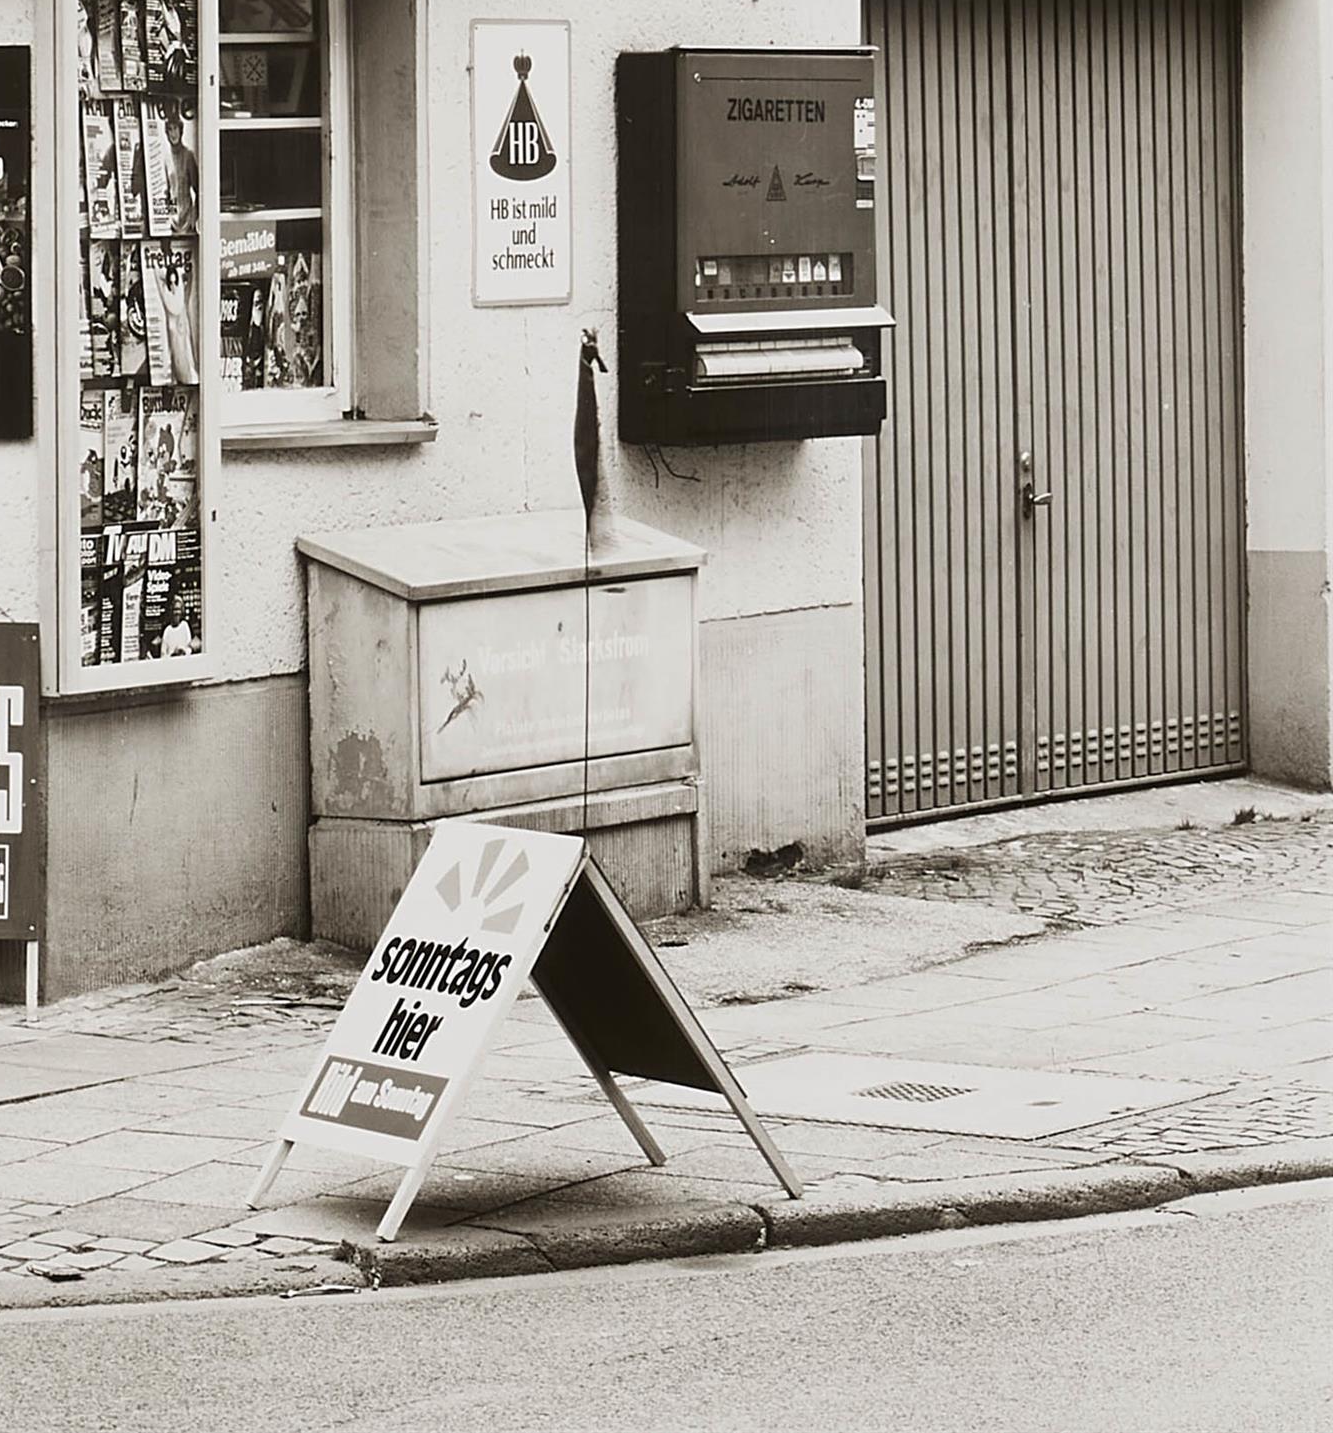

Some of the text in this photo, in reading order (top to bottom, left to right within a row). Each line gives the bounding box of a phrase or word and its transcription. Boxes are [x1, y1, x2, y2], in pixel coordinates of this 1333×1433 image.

[726, 97, 826, 124] ZIGARETTEN
[509, 122, 540, 165] HB
[490, 196, 557, 220] HB ist mild
[512, 222, 536, 245] und
[492, 246, 555, 271] schmeckt
[370, 934, 513, 1009] sonntags
[370, 996, 445, 1062] hier
